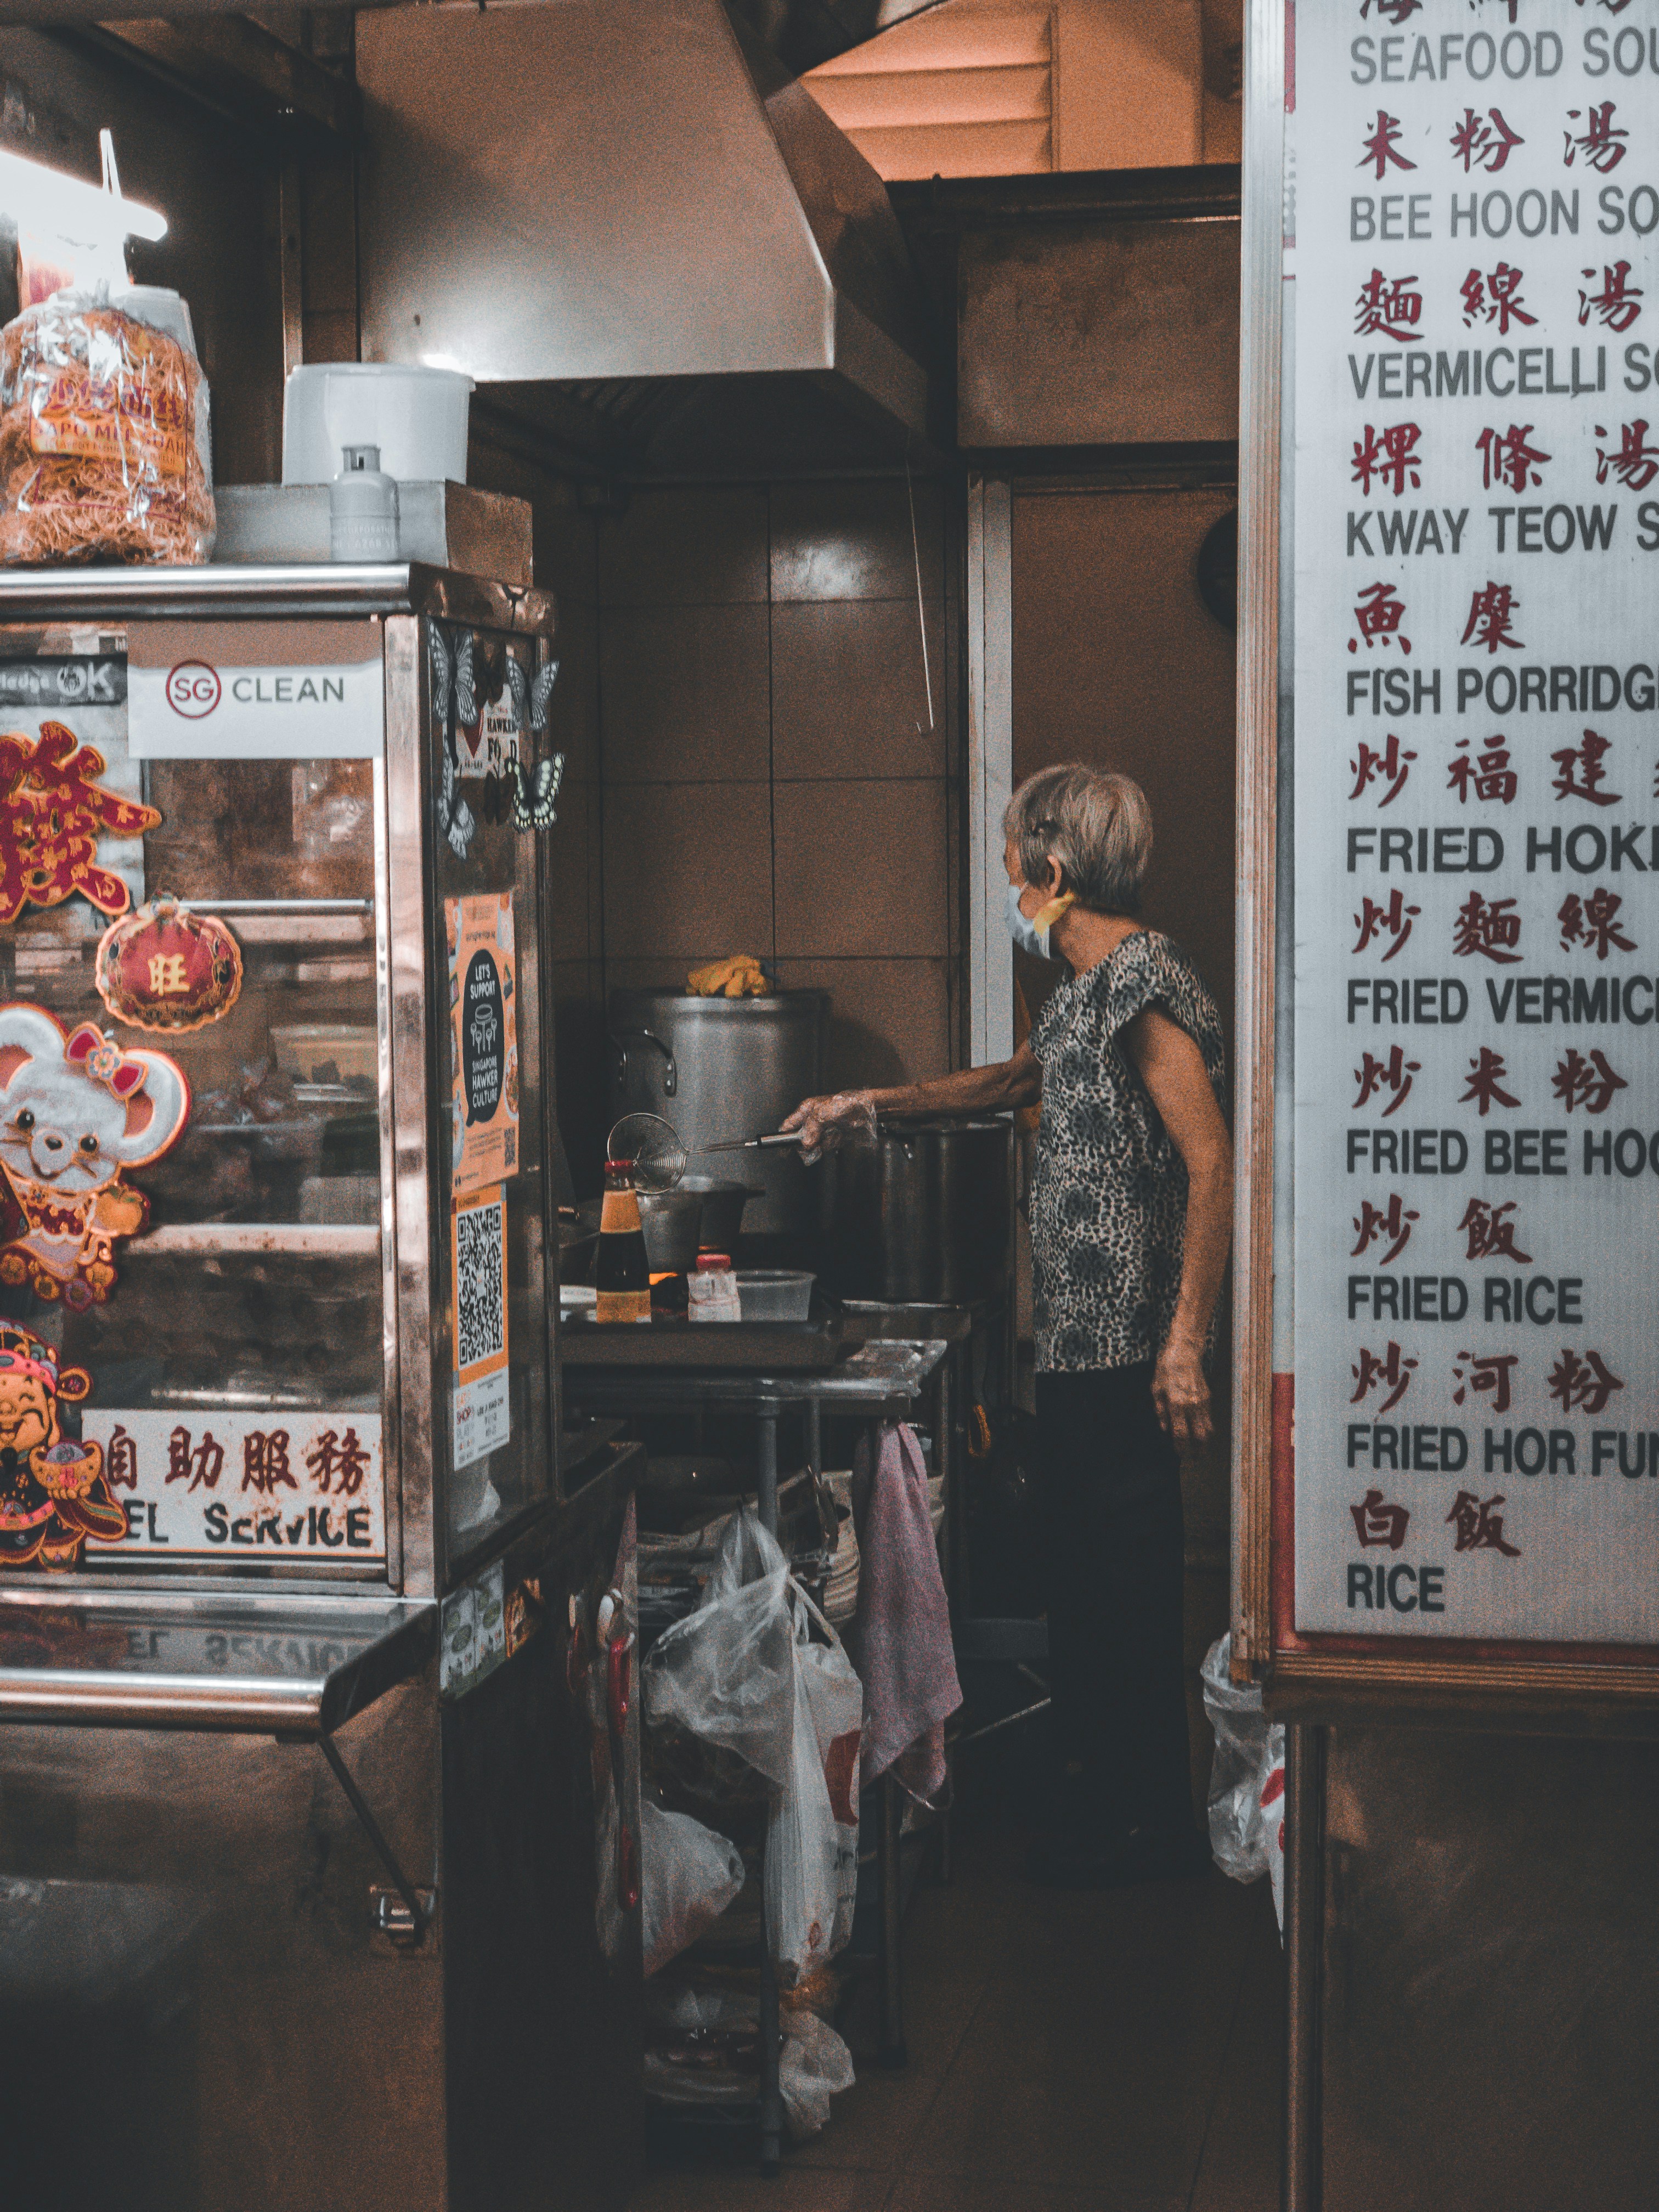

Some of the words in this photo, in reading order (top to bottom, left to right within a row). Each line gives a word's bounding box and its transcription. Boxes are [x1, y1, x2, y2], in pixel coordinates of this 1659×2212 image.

[1349, 30, 1565, 86] SEAFOOD
[1354, 100, 1631, 181] 米粉湯
[1350, 193, 1432, 242] BEE
[1449, 188, 1580, 239] HOON
[1596, 184, 1659, 239] SO
[1352, 259, 1645, 343] 麵線湯
[1347, 345, 1606, 399] VERMICELLI
[1623, 342, 1659, 394] S
[1350, 418, 1659, 498] 粿條湯
[1346, 507, 1470, 557] KWAY
[1487, 503, 1618, 555] TEOW
[57, 661, 115, 702] OK
[174, 677, 215, 702] SG
[232, 678, 345, 703] CLEAN
[1346, 667, 1441, 717] FISH
[1457, 663, 1659, 715] PORRIDG
[1348, 728, 1659, 809] 炒福建
[1346, 826, 1505, 873] FRIED
[1526, 823, 1659, 875] HOK
[1351, 886, 1639, 965] 炒麵線
[148, 953, 190, 996] 旺
[470, 980, 495, 1000] SUPPORT
[1347, 978, 1469, 1025] FRIED
[1485, 974, 1659, 1026] VERMIC
[472, 1070, 498, 1091] HAWKER
[472, 1087, 498, 1108] CULTURE
[1352, 1044, 1630, 1118] 炒米粉
[1346, 1128, 1469, 1176] FRIED
[1484, 1128, 1568, 1176] BEE
[1350, 1193, 1534, 1265] 炒飯
[1347, 1275, 1469, 1323] FRIED
[1483, 1275, 1584, 1327] RICE
[1349, 1340, 1626, 1415] 炒河粉
[108, 1424, 371, 1494] 自助服務
[1346, 1423, 1469, 1472] FRIED
[1483, 1426, 1577, 1477] HOR
[123, 1499, 169, 1543] EL
[1349, 1489, 1522, 1558] 白飯
[1346, 1562, 1446, 1614] RICE
